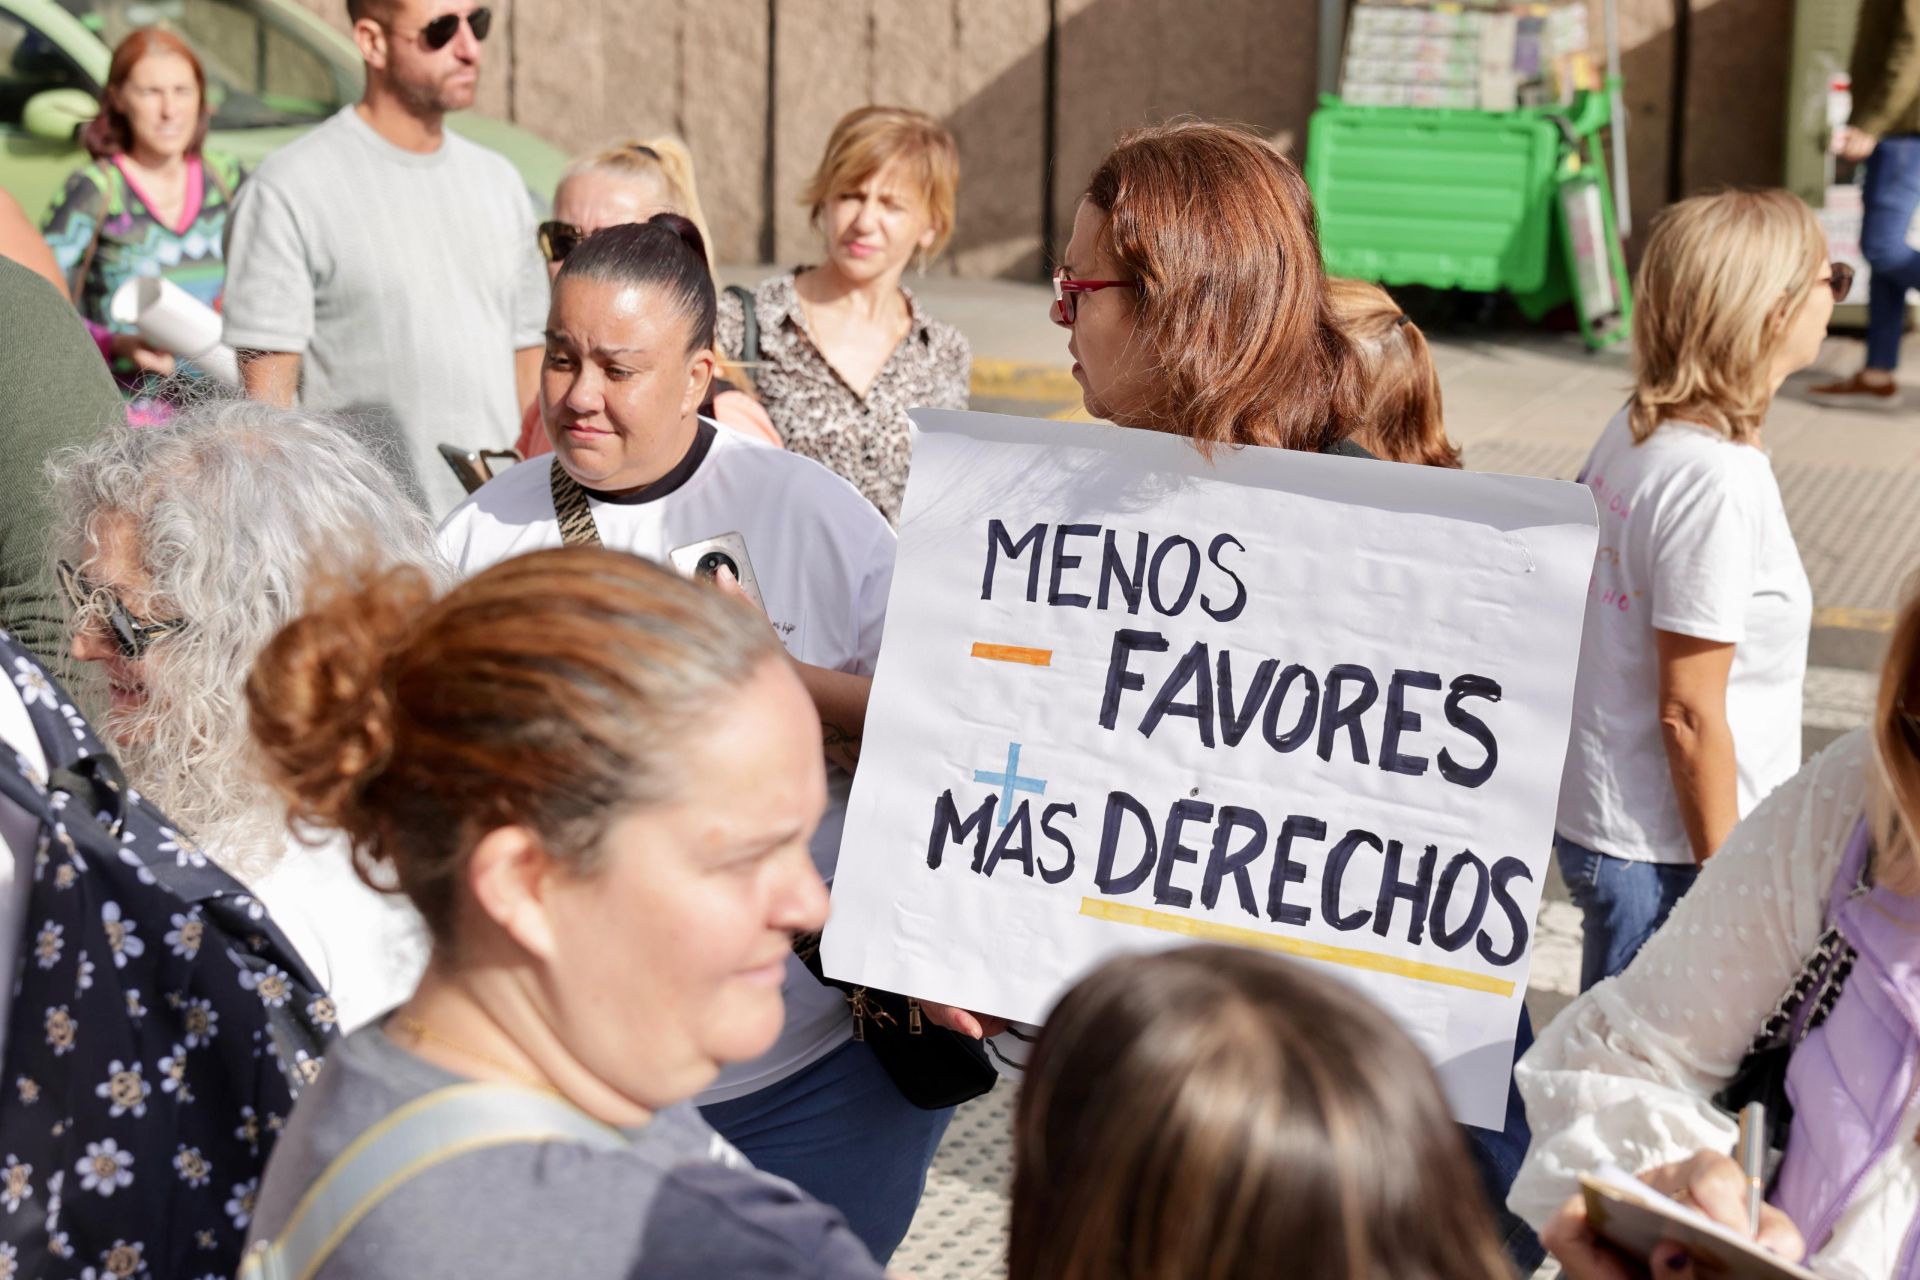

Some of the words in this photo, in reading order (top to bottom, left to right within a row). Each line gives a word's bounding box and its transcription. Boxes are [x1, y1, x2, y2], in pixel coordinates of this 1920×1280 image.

[980, 519, 1247, 622] MENOS
[1098, 628, 1503, 789] FAVORES
[926, 788, 1077, 885] MAS
[1094, 790, 1534, 967] DERECHOS
